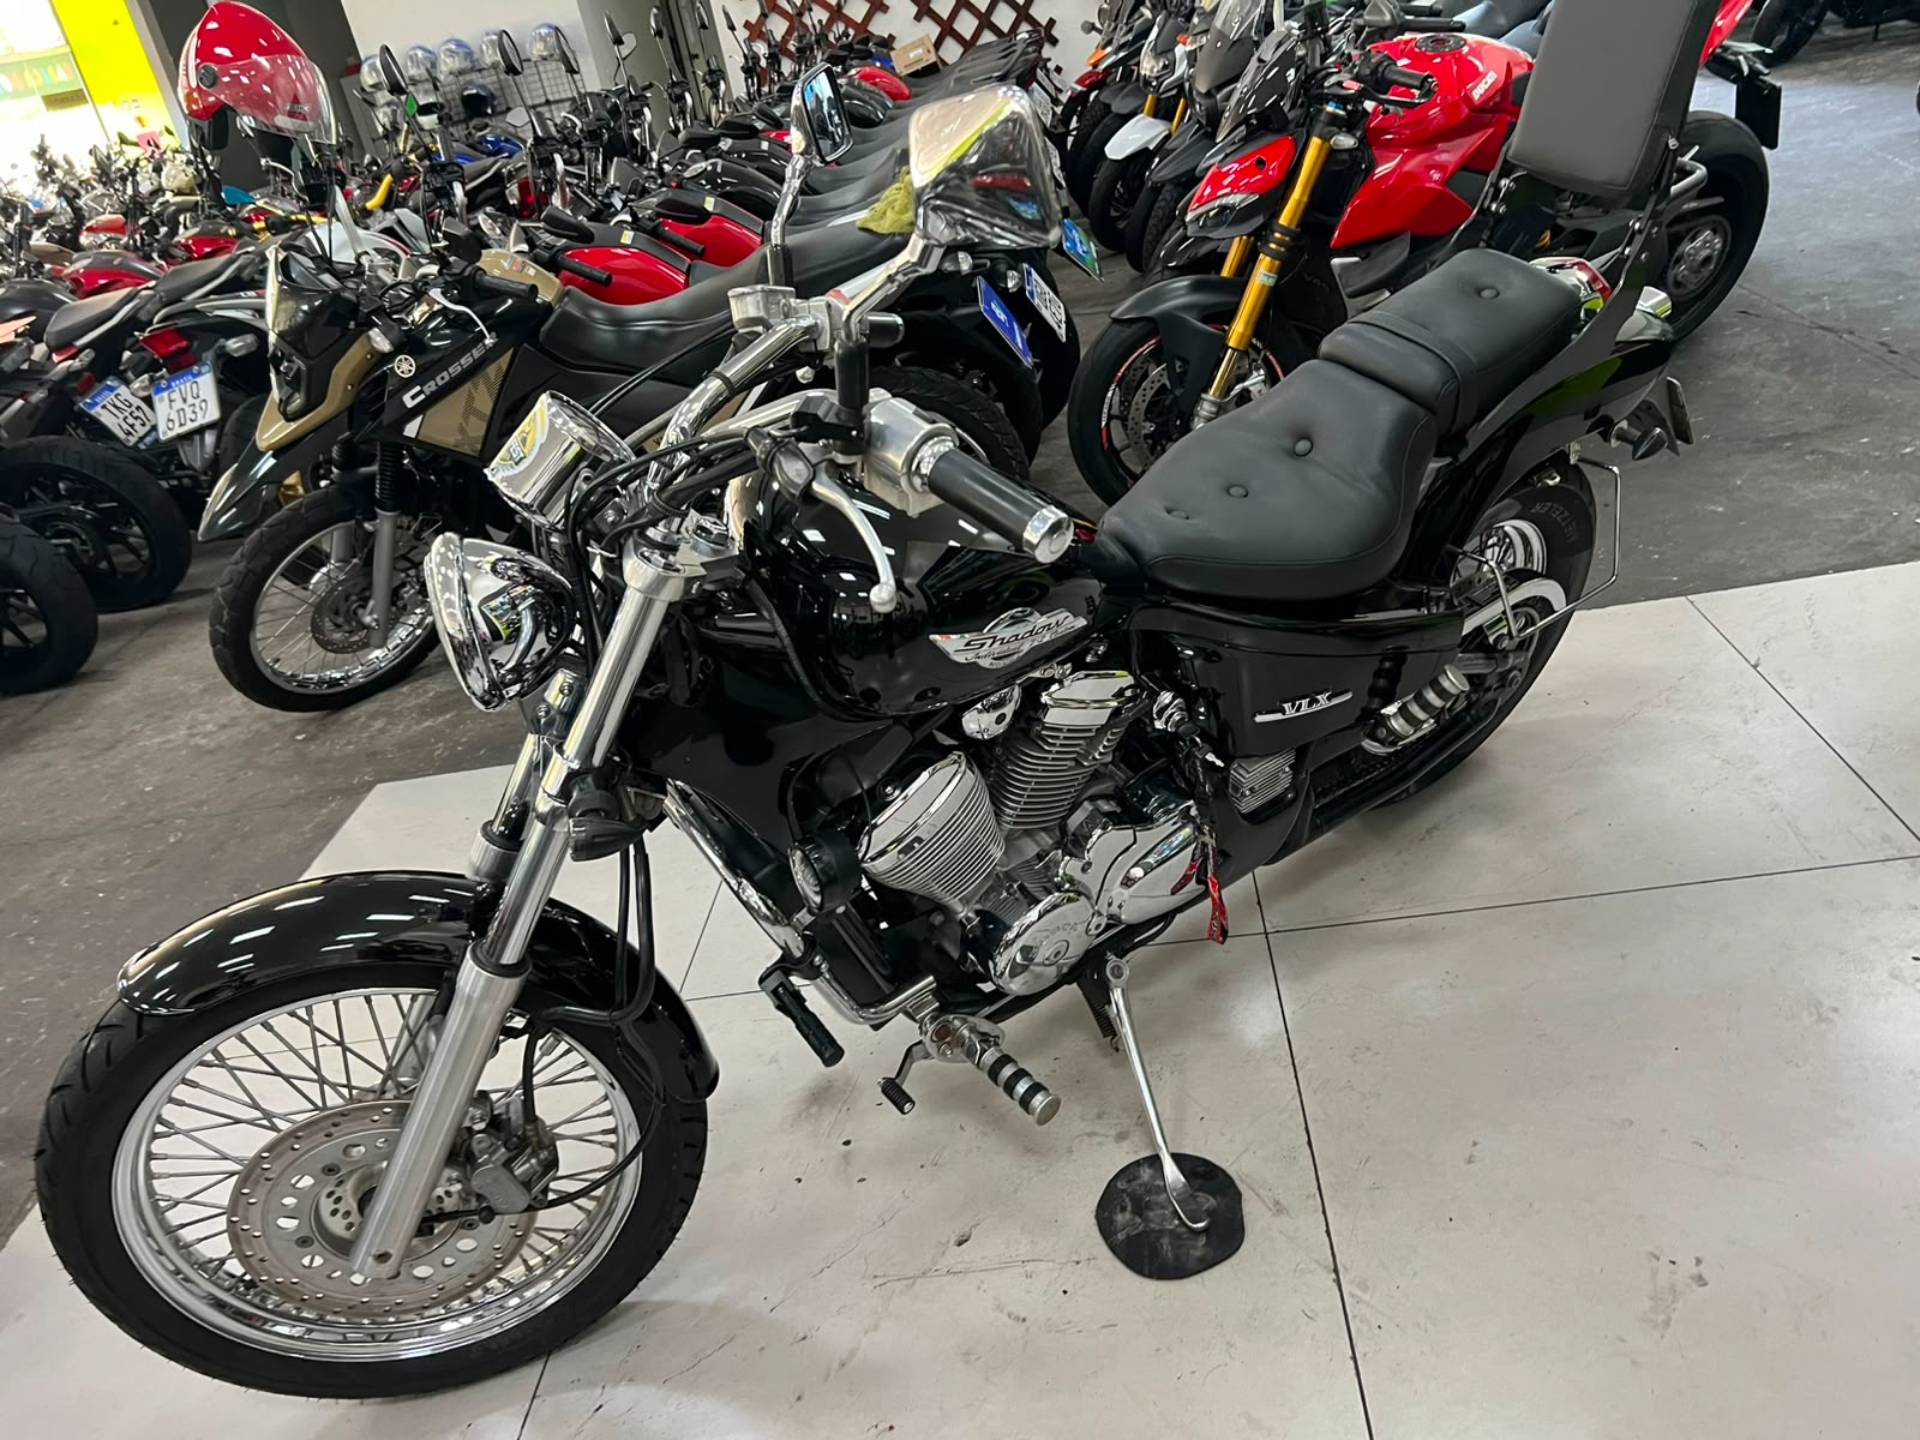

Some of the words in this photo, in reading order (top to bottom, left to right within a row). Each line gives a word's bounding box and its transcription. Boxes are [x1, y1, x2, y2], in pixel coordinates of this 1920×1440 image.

[101, 392, 133, 419] TKG
[167, 381, 200, 410] FVQ
[118, 405, 151, 438] 4F57
[166, 399, 209, 431] 6D39
[954, 615, 1071, 653] Shadow
[1282, 691, 1332, 714] VLX
